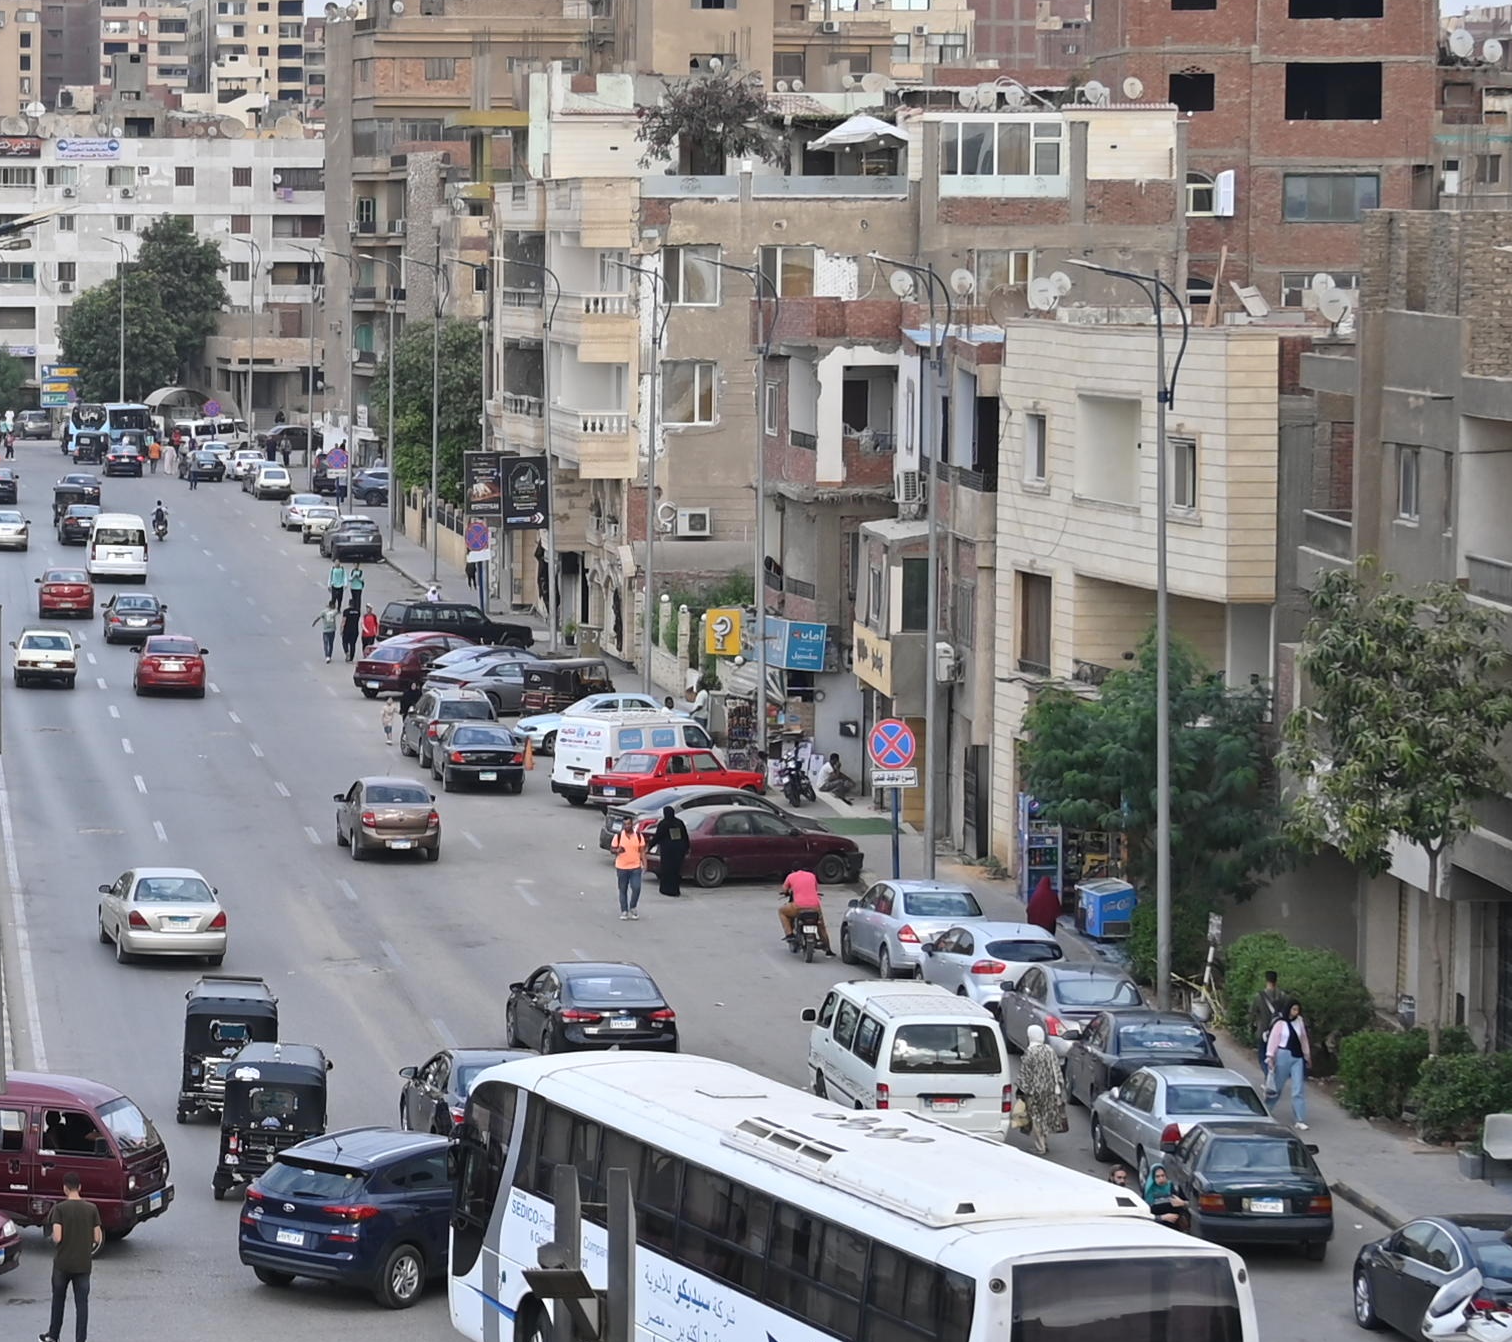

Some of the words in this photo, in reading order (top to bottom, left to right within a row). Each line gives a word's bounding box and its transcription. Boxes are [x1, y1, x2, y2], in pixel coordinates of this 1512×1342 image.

[511, 1199, 539, 1225] SEDICO
[644, 1263, 672, 1294] للأدوية
[673, 1277, 711, 1315] سيديكو
[712, 1296, 736, 1327] شركة
[645, 1310, 665, 1327] مصر
